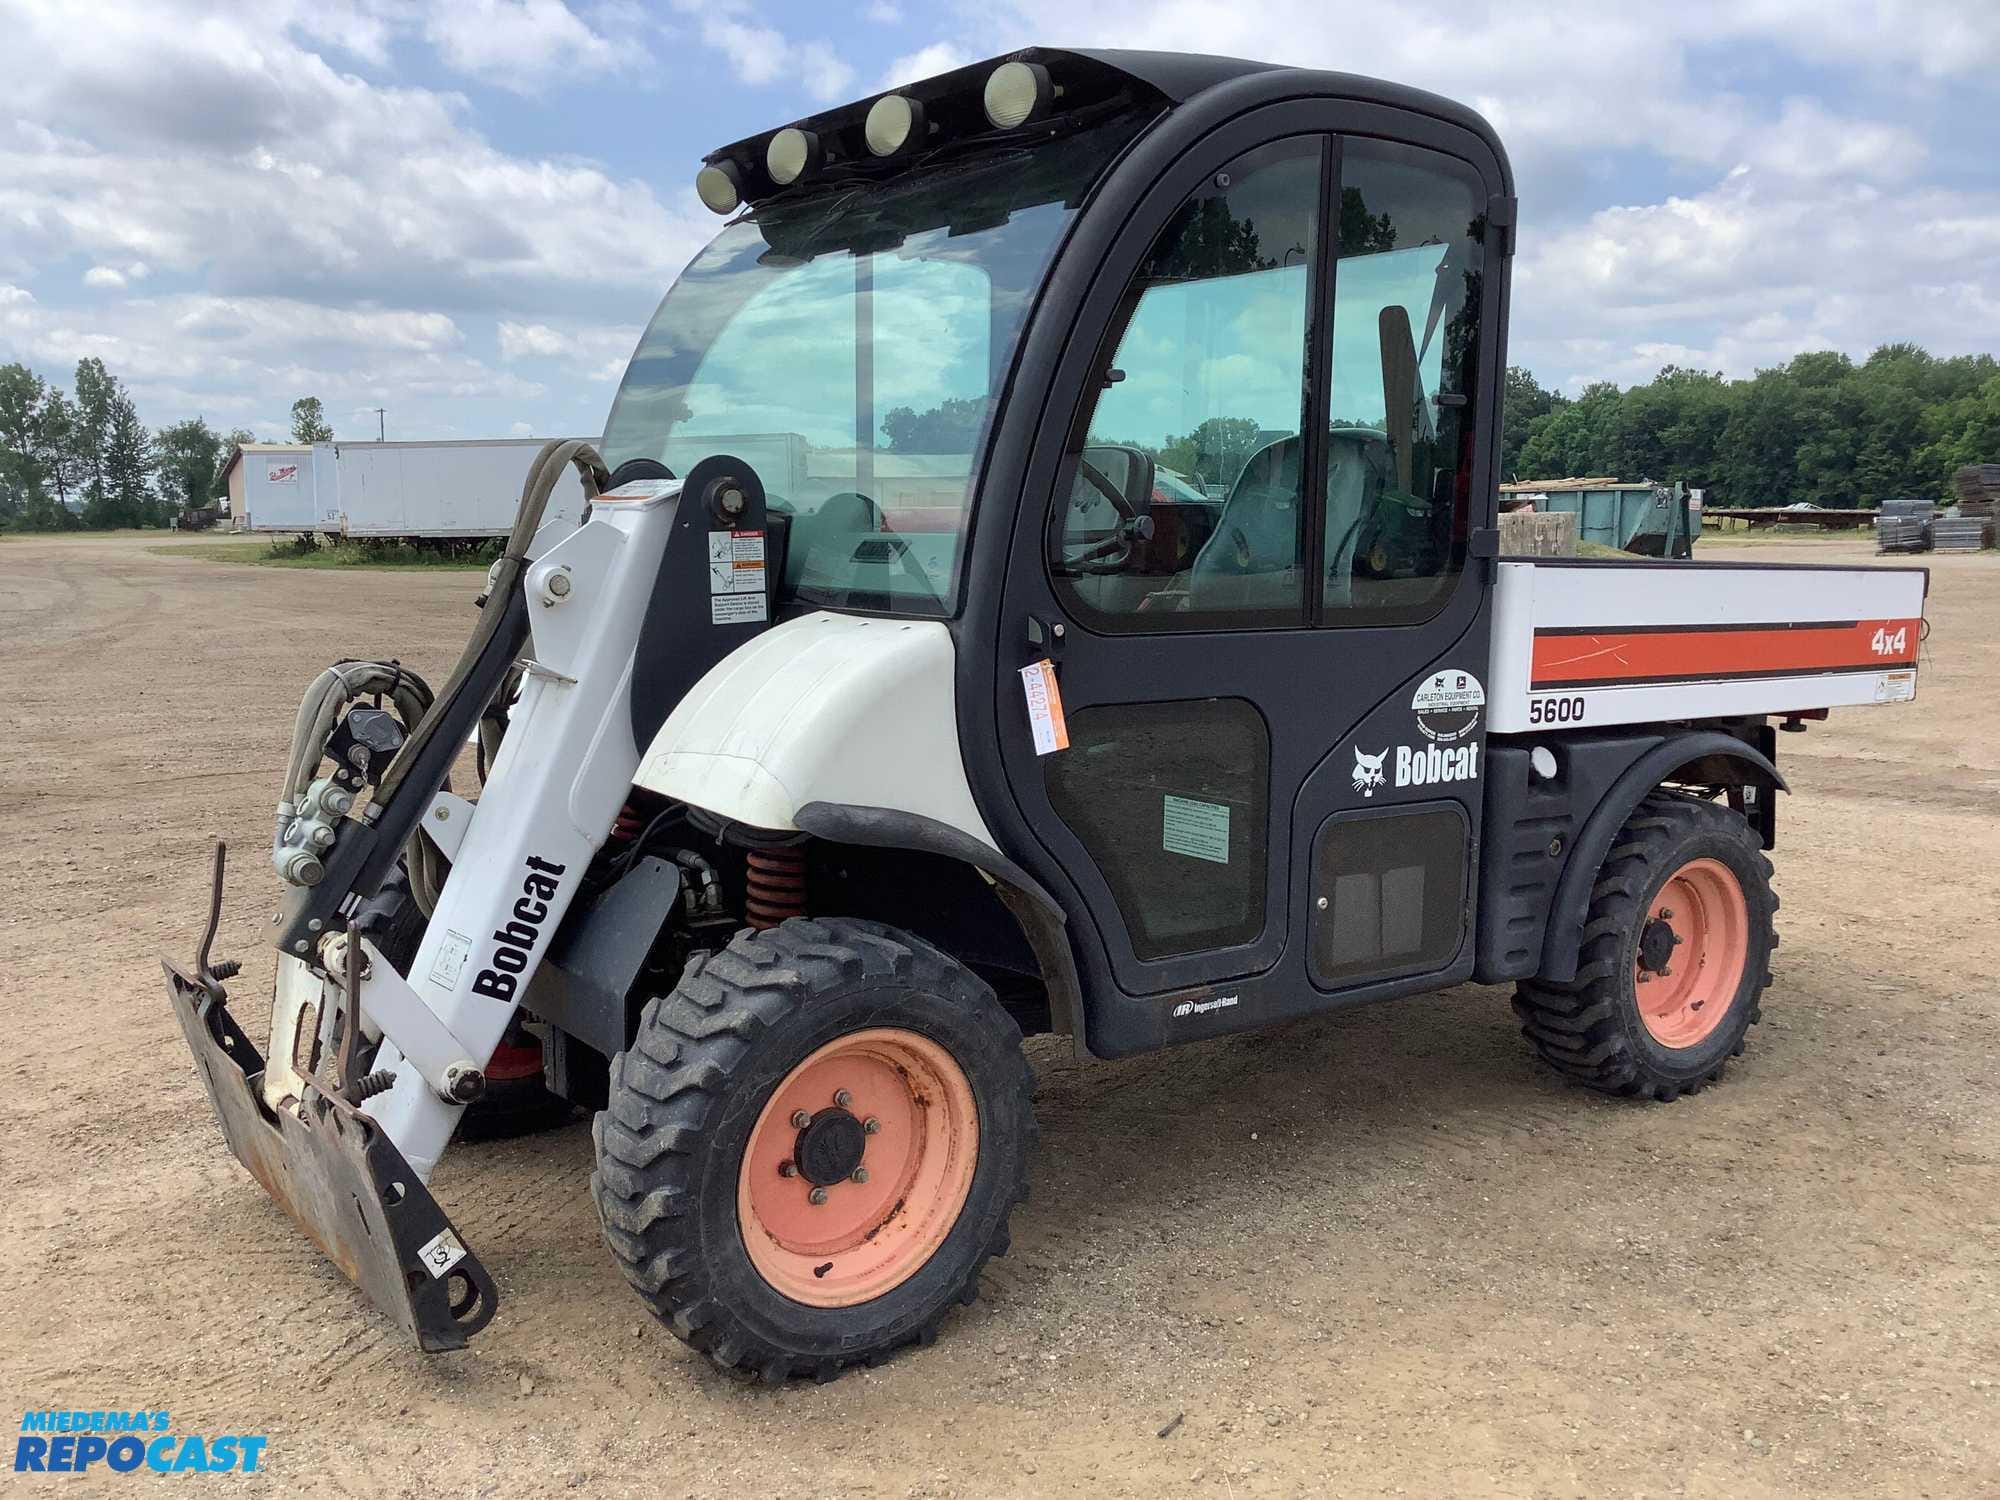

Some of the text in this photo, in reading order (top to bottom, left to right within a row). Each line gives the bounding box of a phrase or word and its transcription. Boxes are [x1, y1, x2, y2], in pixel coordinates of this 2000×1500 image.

[1872, 627, 1906, 655] 4x4
[1417, 692, 1443, 702] CARLETON
[1444, 690, 1472, 700] EQUIPMENT
[1530, 697, 1585, 724] 5600
[1395, 742, 1479, 787] Bobcat
[472, 855, 566, 1003] Bobcat
